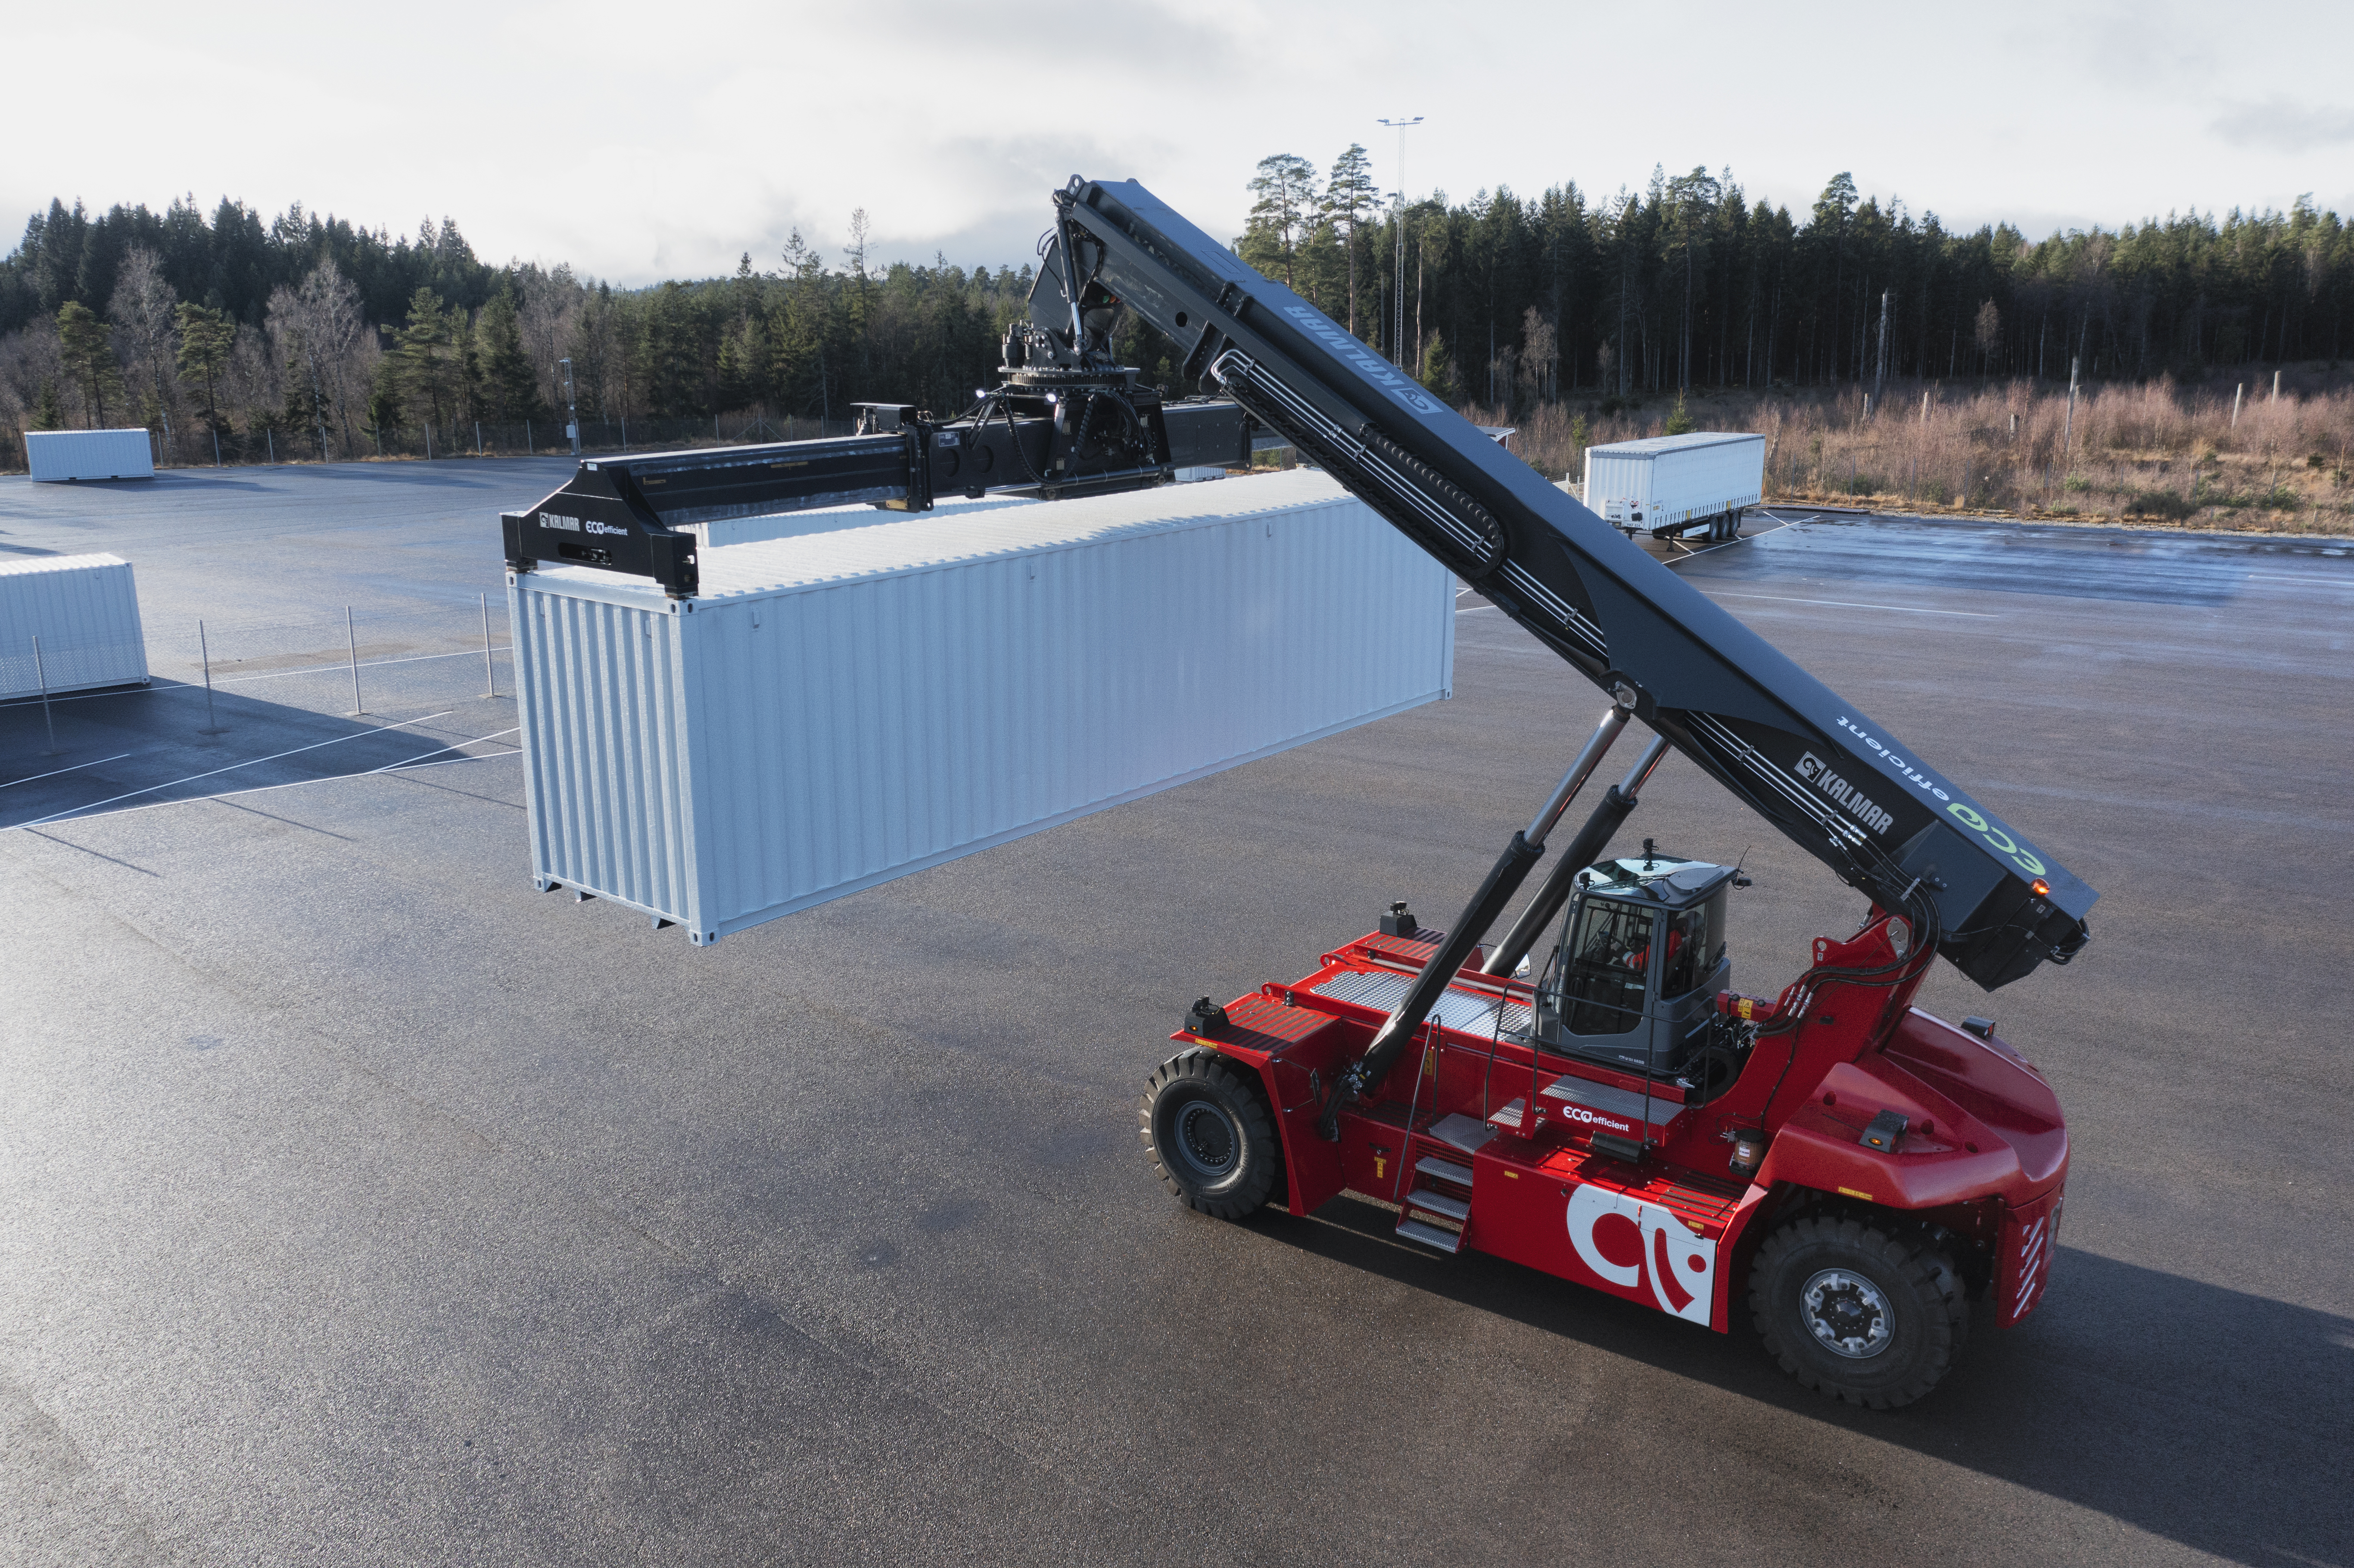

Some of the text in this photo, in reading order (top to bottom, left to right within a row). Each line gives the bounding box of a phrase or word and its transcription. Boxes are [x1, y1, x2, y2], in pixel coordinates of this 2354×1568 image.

[1283, 306, 1405, 386] KALMAR
[549, 514, 580, 532] KALMAR
[1816, 769, 1893, 835] KALMAR
